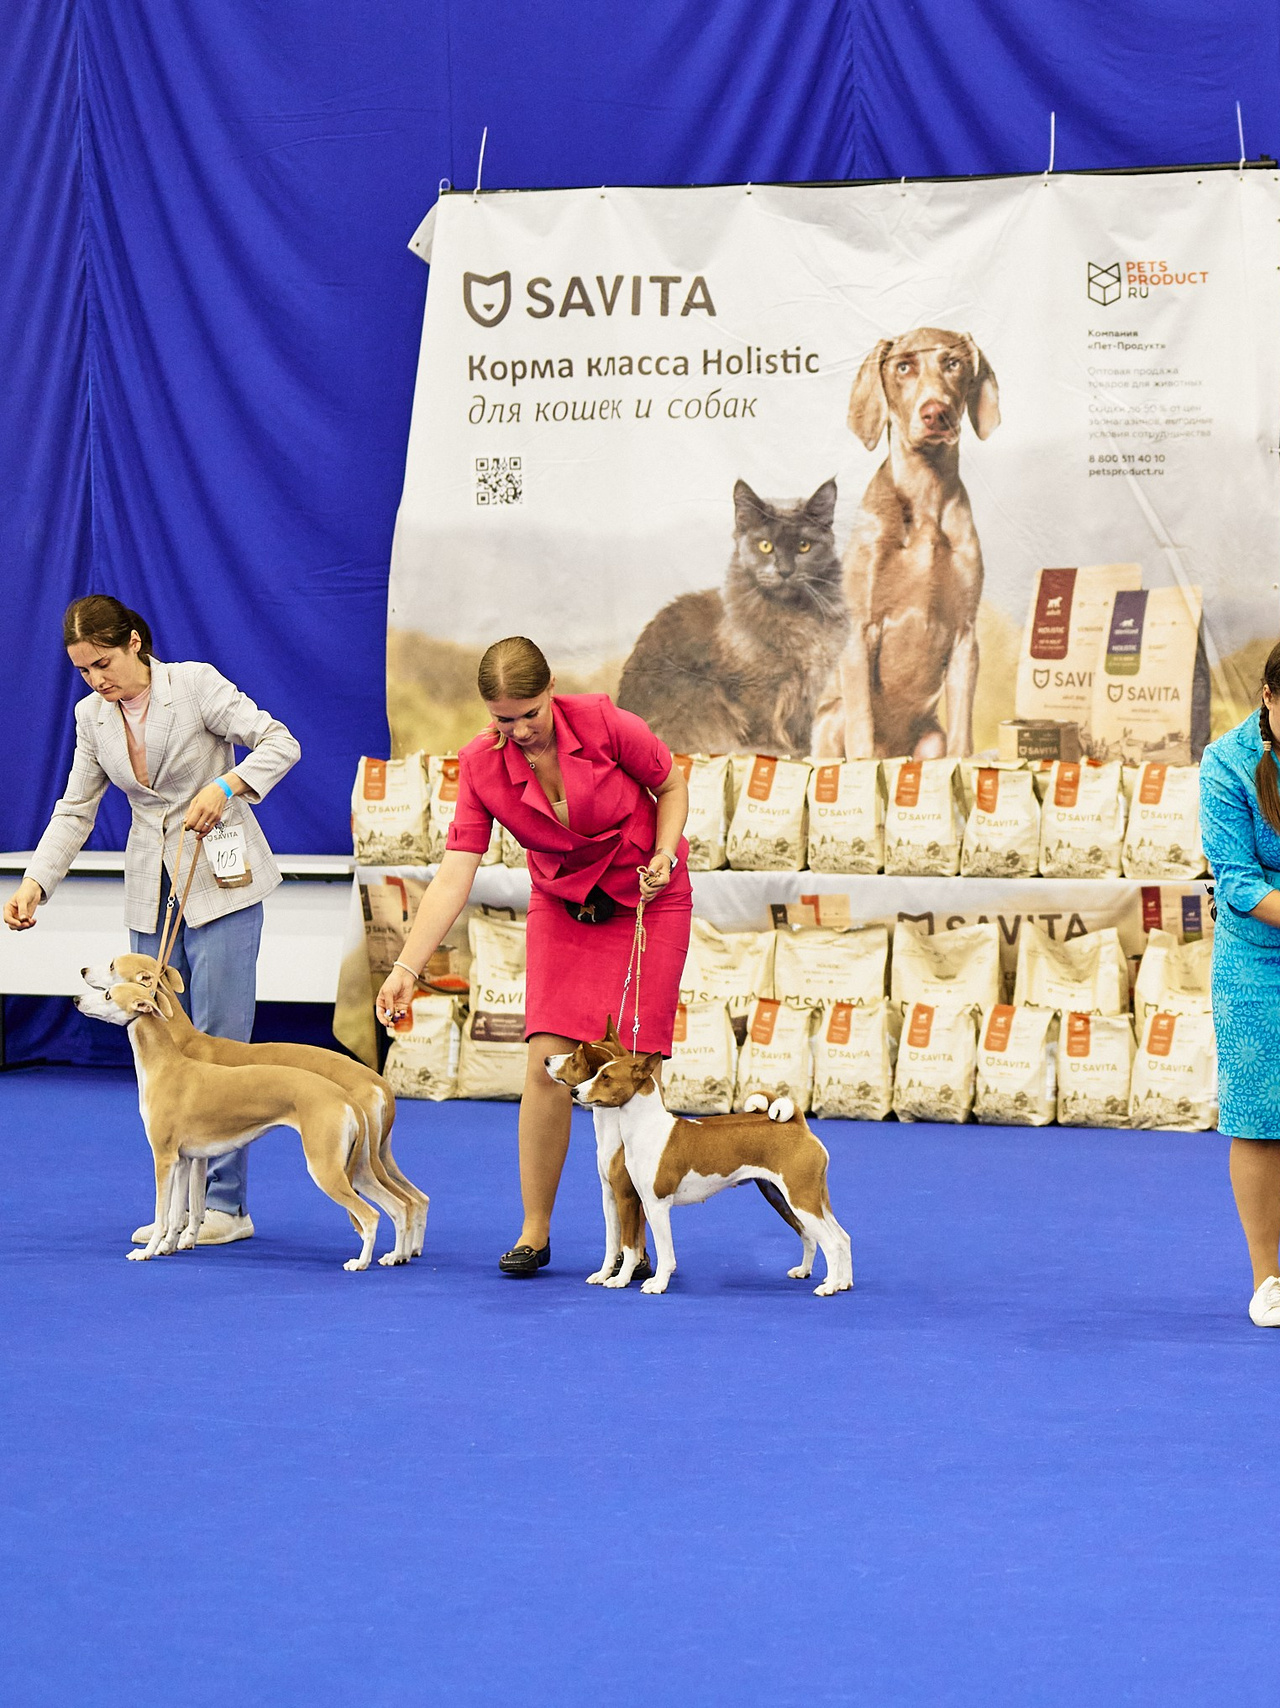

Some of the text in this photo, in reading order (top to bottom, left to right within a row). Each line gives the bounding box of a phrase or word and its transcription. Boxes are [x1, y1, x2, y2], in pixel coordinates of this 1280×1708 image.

[1126, 260, 1168, 273] PETS
[1128, 272, 1209, 286] PRODUCT
[526, 275, 717, 319] SAVITA
[1128, 286, 1149, 299] RU
[1087, 329, 1139, 338] Компания
[467, 346, 820, 387] Корма класса Holistic
[468, 387, 759, 425] для кошек и собак
[1089, 455, 1095, 463] 8
[1138, 454, 1151, 463] 40
[1155, 454, 1166, 463] 10
[1089, 467, 1164, 477] petsproduct.ru
[1054, 671, 1096, 688] SAVI
[1127, 686, 1180, 701] SAVITA
[1067, 812, 1102, 822] SAVITA
[213, 832, 238, 840] SAVITA
[484, 989, 523, 1004] SAVI
